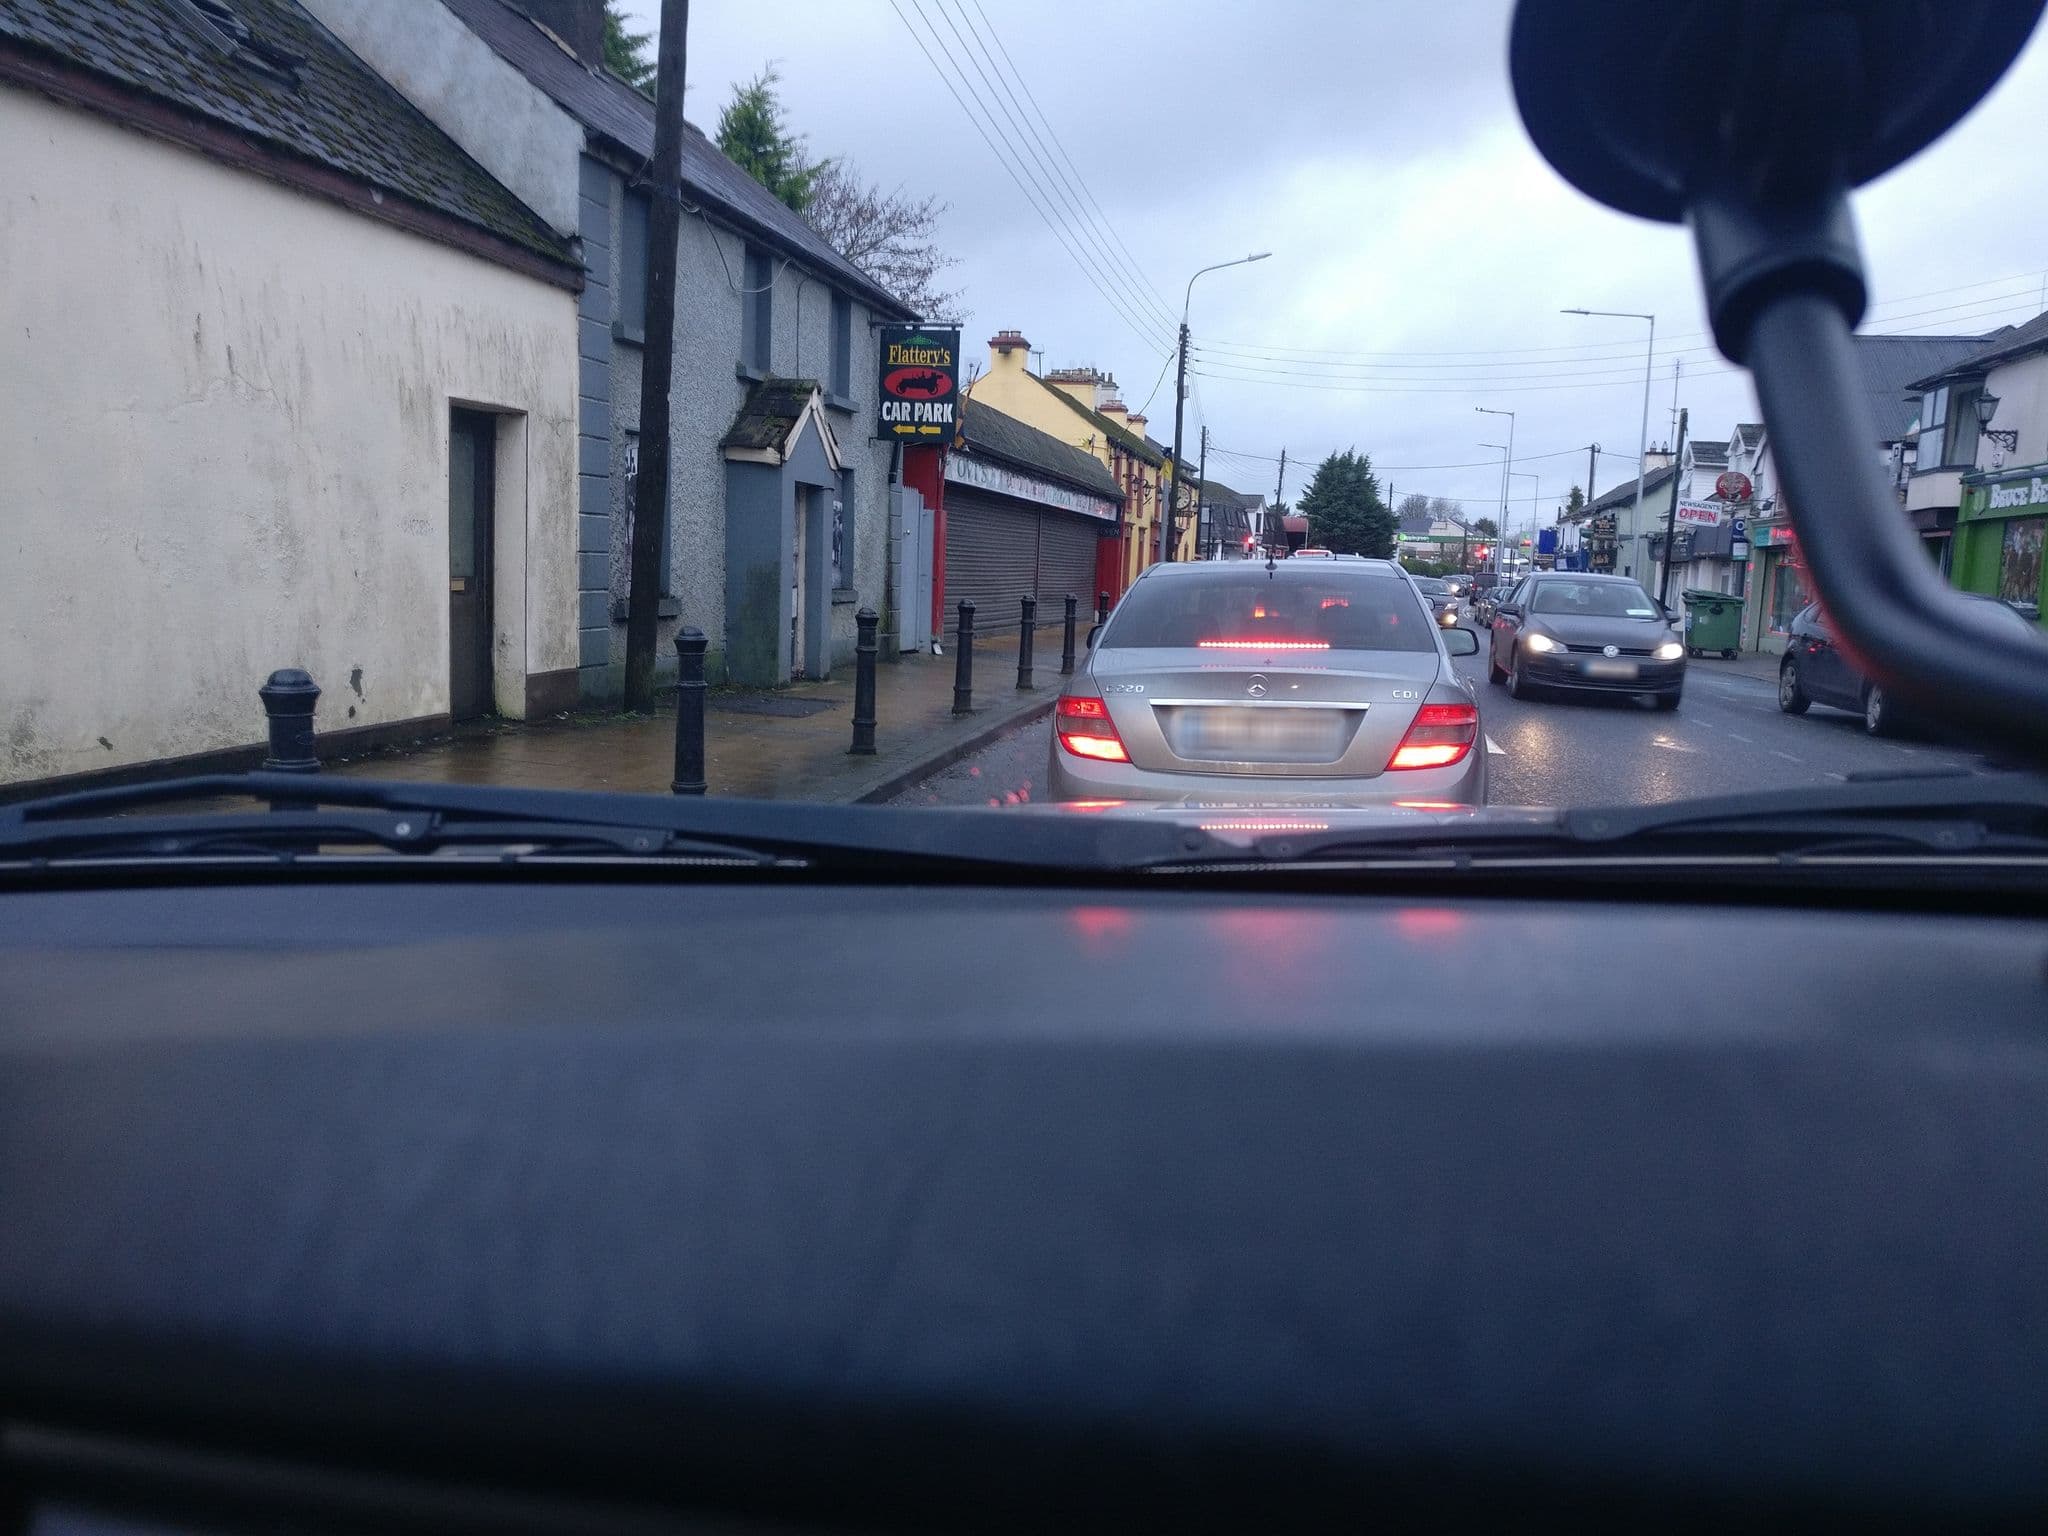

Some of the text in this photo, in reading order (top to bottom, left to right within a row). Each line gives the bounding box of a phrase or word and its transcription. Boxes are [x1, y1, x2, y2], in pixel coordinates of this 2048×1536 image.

[888, 344, 951, 367] Flattery's
[882, 401, 953, 423] CAR PARK
[1678, 508, 1717, 523] OPEN
[1392, 690, 1418, 699] CDI
